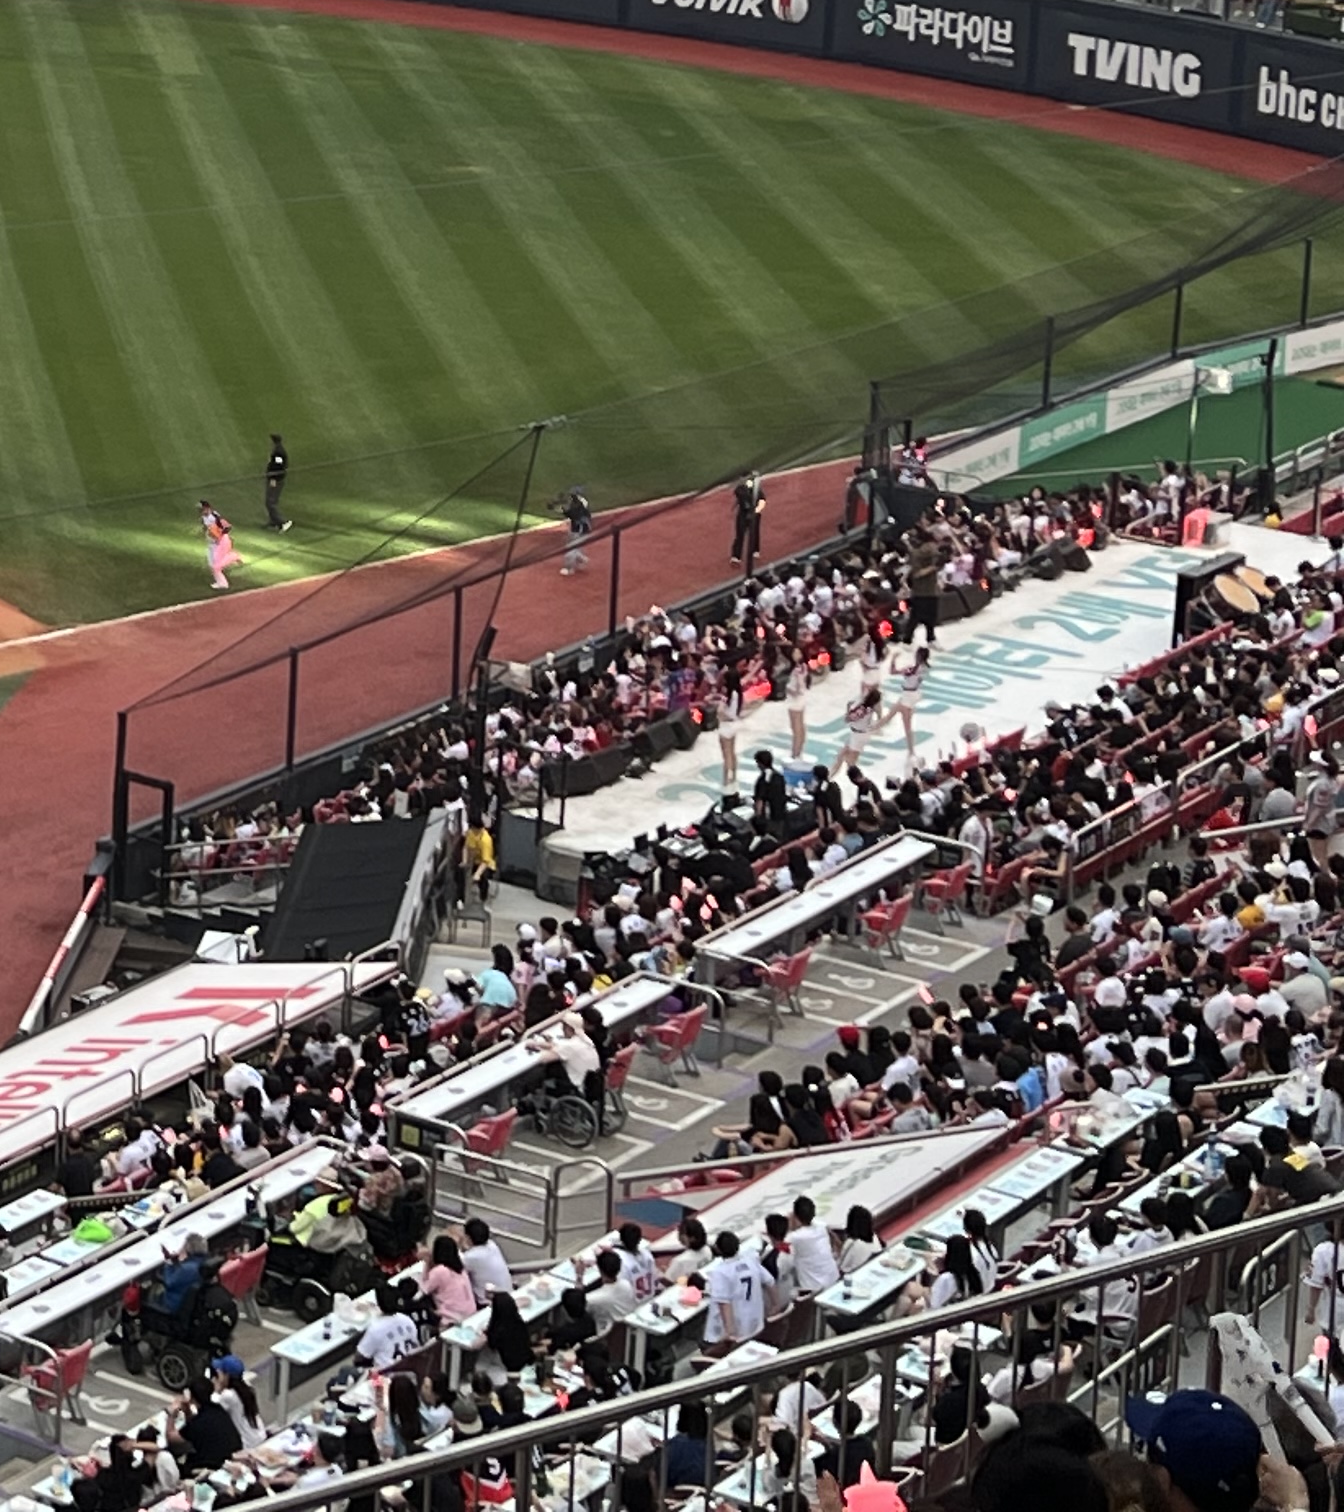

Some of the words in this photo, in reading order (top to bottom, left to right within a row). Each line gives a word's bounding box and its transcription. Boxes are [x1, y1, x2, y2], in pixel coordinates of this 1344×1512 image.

[891, 2, 1015, 56] 파라다이브
[1066, 31, 1203, 100] TVING
[1256, 64, 1318, 124] bhc
[121, 984, 320, 1027] K
[739, 1276, 753, 1302] 7
